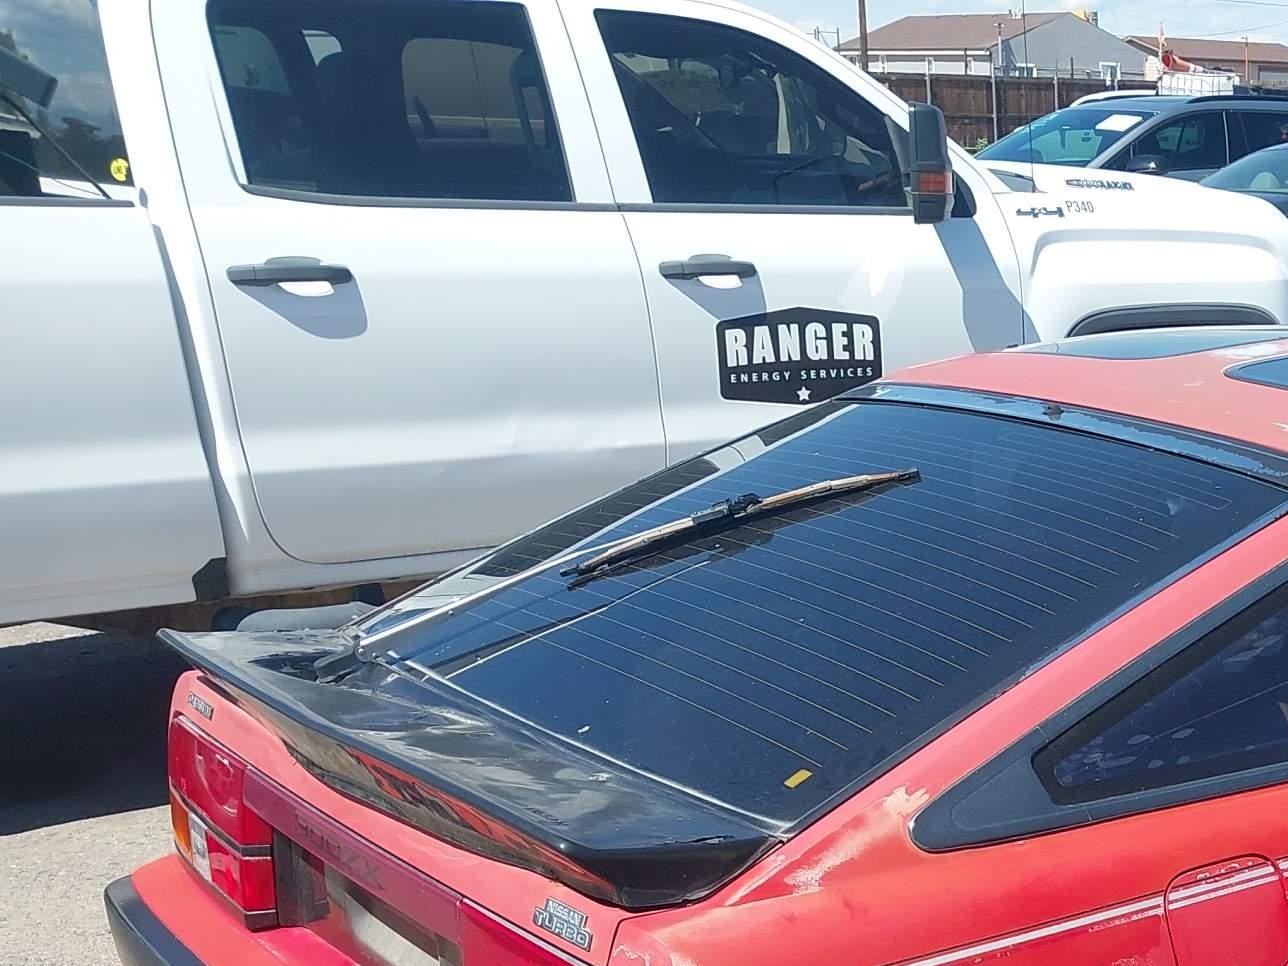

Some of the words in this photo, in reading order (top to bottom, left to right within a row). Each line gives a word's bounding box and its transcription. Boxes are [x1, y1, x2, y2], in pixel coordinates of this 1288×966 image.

[1065, 200, 1095, 213] P340
[724, 322, 875, 368] RANGER
[730, 370, 791, 384] ENERGY
[800, 366, 874, 380] SERVICES
[546, 899, 582, 927] NISSAN
[534, 907, 590, 950] TURBO
